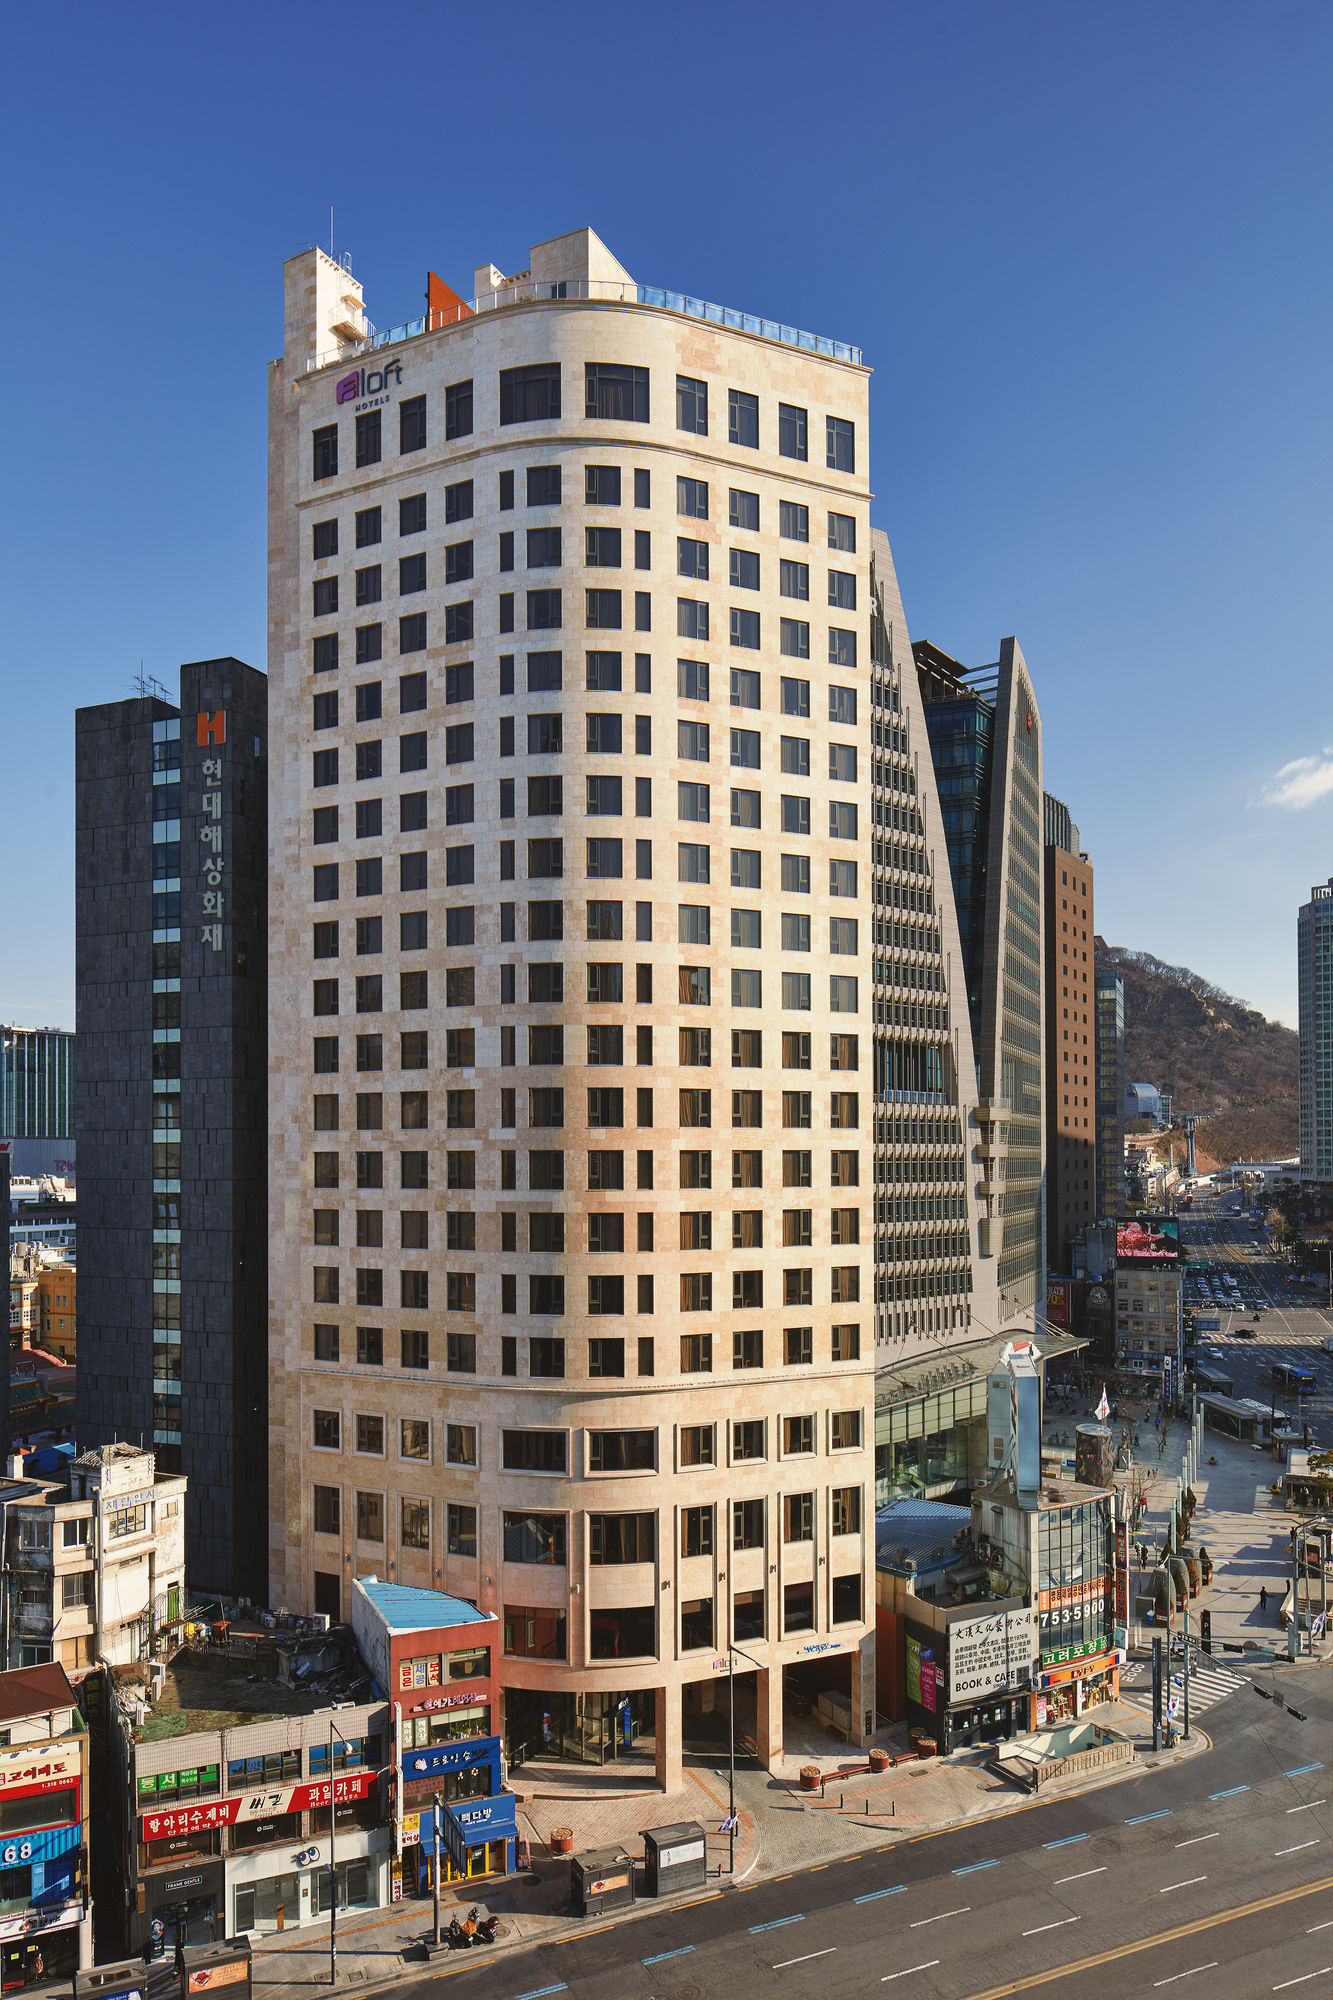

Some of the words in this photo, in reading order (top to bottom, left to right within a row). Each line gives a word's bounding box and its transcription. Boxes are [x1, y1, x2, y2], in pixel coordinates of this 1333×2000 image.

[355, 394, 390, 412] HOTELS
[200, 758, 224, 951] 현대해상화재
[1044, 1641, 1097, 1664] 고려포장
[402, 1666, 412, 1688] 금은
[415, 1664, 425, 1685] 세공
[430, 1662, 439, 1683] 보석
[956, 1678, 982, 1692] BOOK
[985, 1677, 992, 1685] &
[994, 1670, 1015, 1683] CAFE
[310, 1800, 328, 1808] Beer
[149, 1805, 229, 1833] 항아리수제비
[461, 1807, 492, 1822] 빽다방
[5, 1843, 32, 1862] 68
[167, 1880, 183, 1889] FRAME
